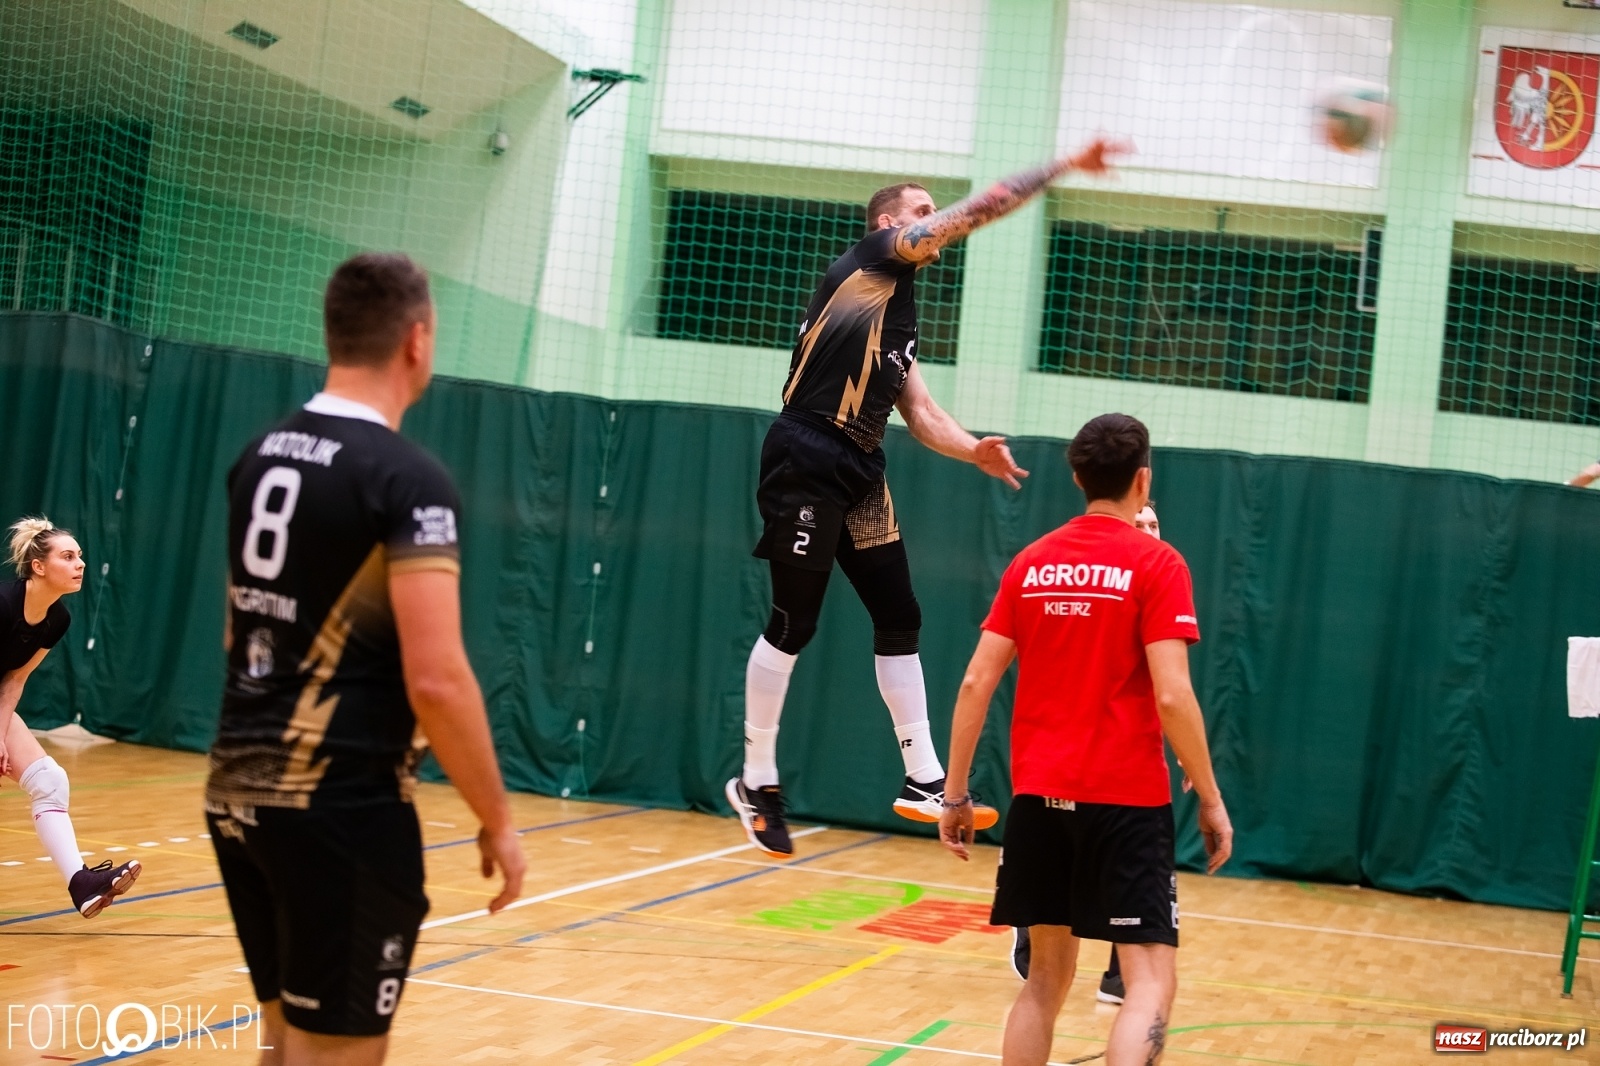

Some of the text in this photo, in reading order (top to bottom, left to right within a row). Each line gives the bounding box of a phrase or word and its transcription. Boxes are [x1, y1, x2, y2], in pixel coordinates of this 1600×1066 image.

[242, 466, 302, 580] 8
[793, 531, 810, 556] 2
[1022, 563, 1133, 592] AGROTIM
[1044, 601, 1092, 617] KIETRZ
[1043, 796, 1076, 811] TEAM
[376, 977, 400, 1016] 8
